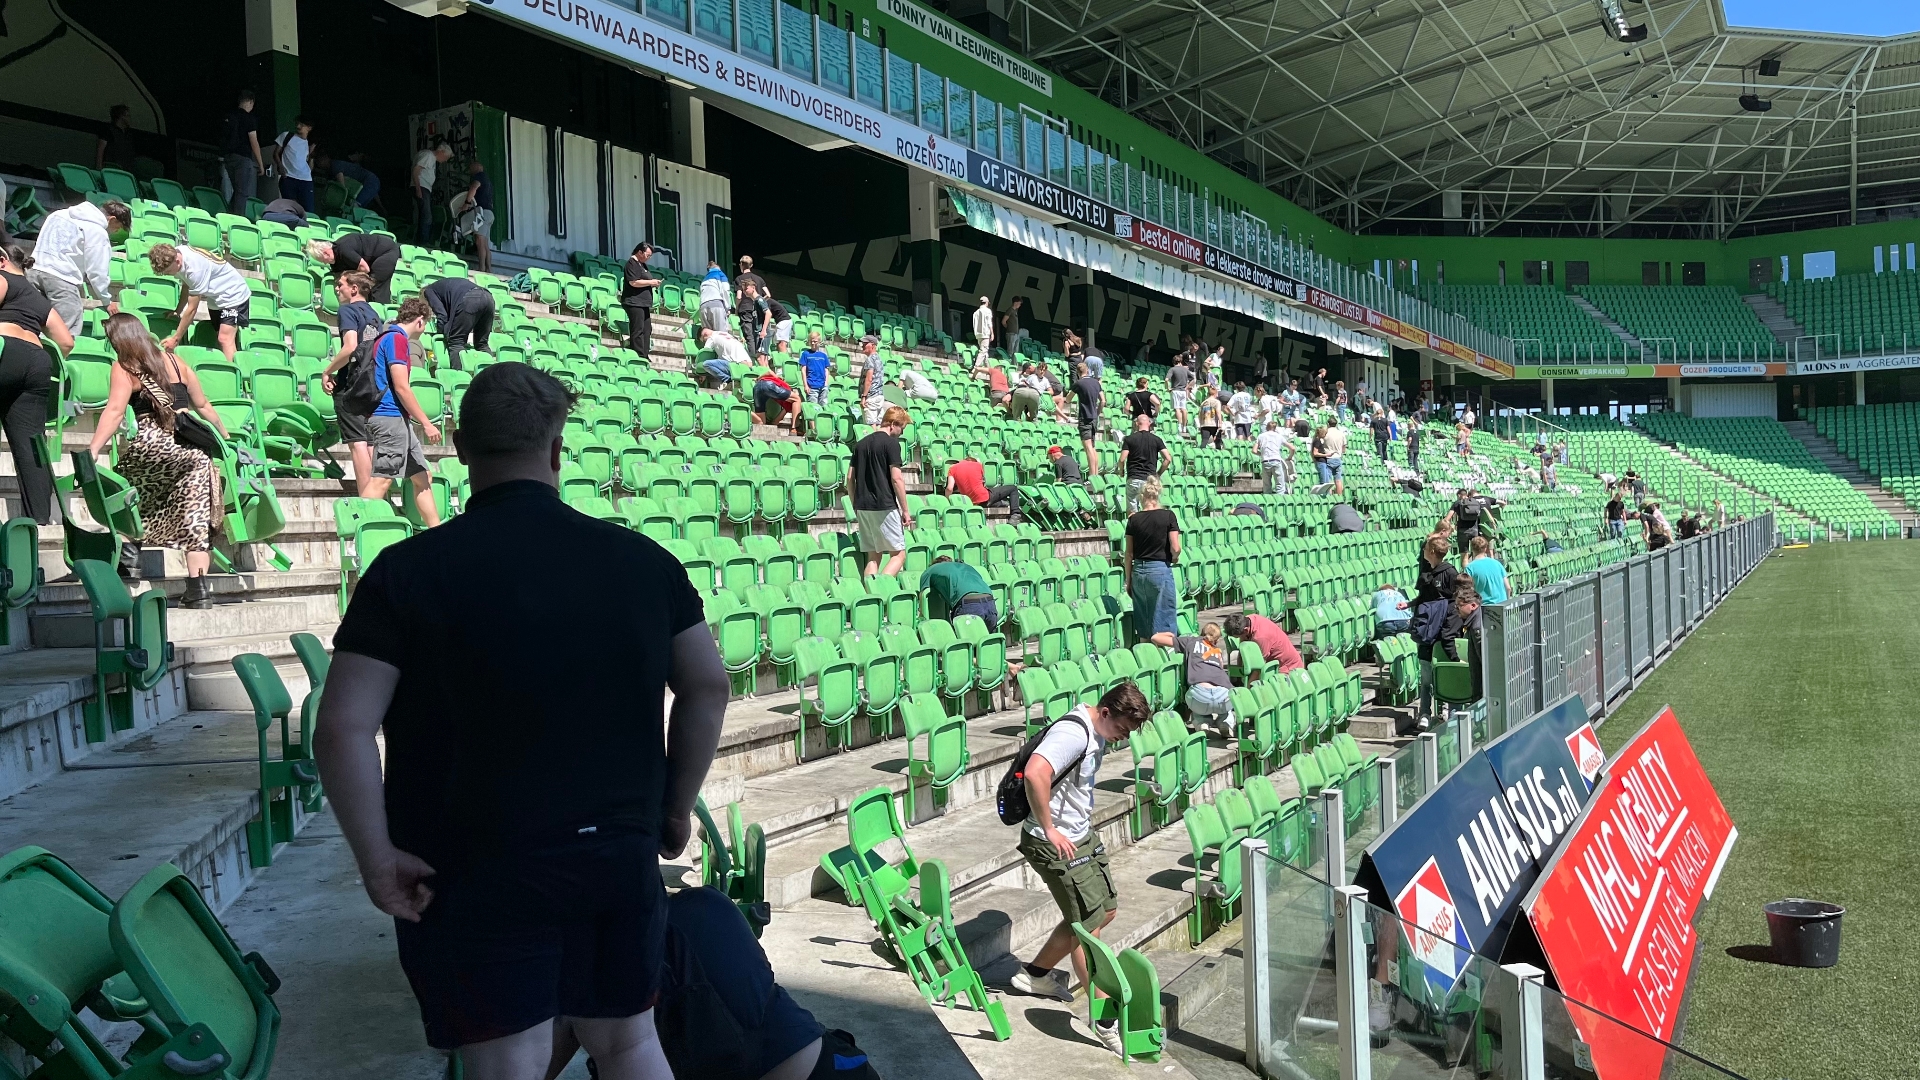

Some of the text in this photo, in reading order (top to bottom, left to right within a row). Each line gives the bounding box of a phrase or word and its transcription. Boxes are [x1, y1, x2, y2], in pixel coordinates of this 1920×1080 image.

[887, 0, 1047, 91] TONNY VAN LEEUWEN TRIBUNE
[714, 60, 729, 82] &
[734, 68, 882, 139] BEWINDVOERDERS
[896, 136, 965, 179] ROZENSTAD
[980, 160, 1108, 229] OF JEWORSTLUST.EU
[1115, 223, 1131, 236] LUST
[1140, 220, 1201, 262] bestel online
[1204, 246, 1294, 297] de lekkerste droge worst
[1311, 289, 1319, 305] OF
[1541, 367, 1627, 376] BONSEMAVERPAKKING
[1457, 765, 1582, 926] AMASUS.nl
[1573, 820, 1641, 953] MHC
[1419, 906, 1453, 956] AMASUS
[1633, 914, 1682, 1039] LEASEN
[1670, 820, 1711, 898] MAKEN
